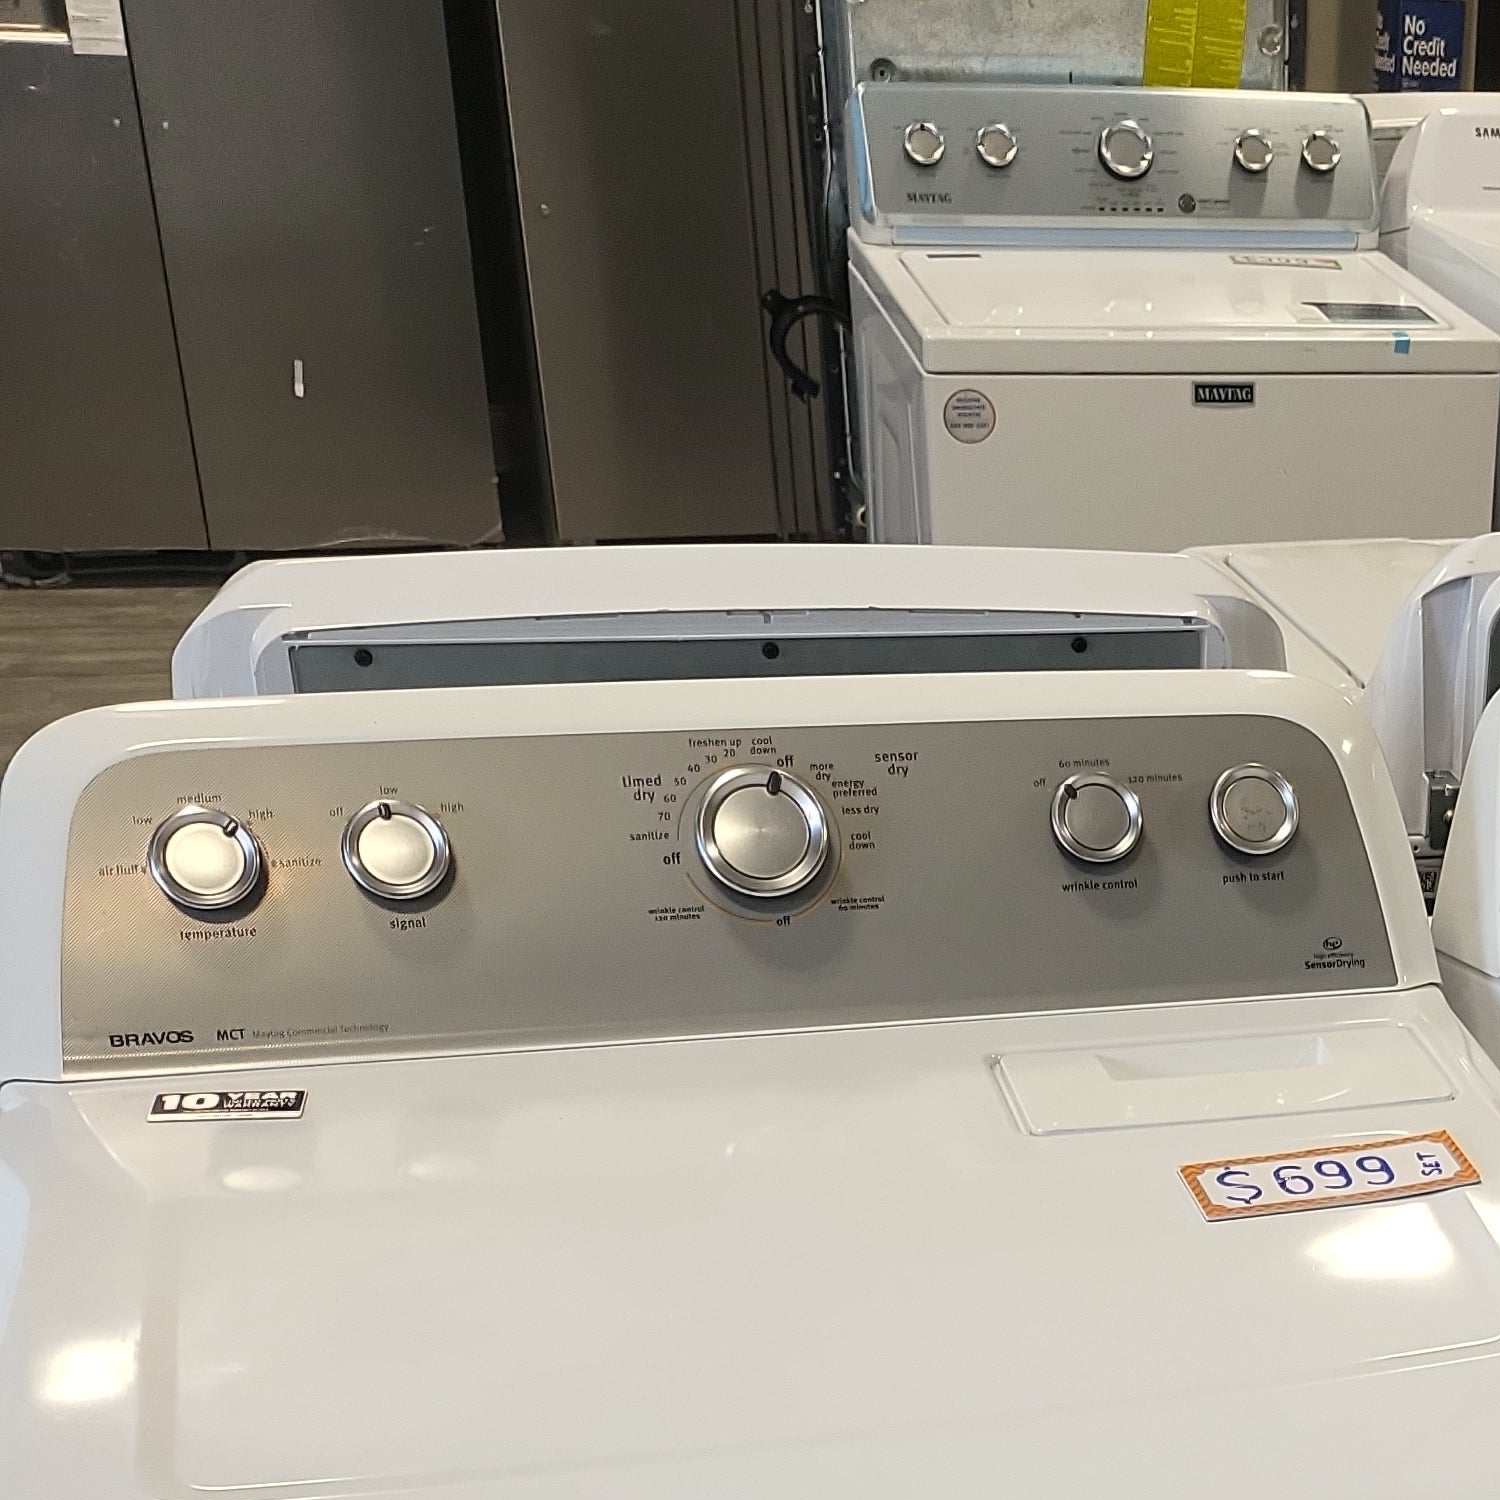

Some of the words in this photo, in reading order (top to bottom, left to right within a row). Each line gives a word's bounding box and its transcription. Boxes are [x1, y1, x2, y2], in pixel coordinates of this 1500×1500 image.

[1404, 14, 1426, 36] No
[1403, 35, 1446, 57] Credit
[1401, 55, 1457, 78] Needed
[1197, 387, 1252, 401] MAYTAG
[688, 738, 727, 748] freshen
[729, 738, 742, 749] up
[751, 736, 773, 746] cool
[723, 749, 736, 757] 20
[750, 746, 776, 755] down
[704, 755, 718, 764] 30
[776, 755, 794, 768] off
[874, 751, 919, 763] sensor
[687, 764, 700, 773] 40
[809, 763, 834, 771] more
[1058, 759, 1071, 769] 60
[1073, 757, 1110, 768] minutes
[887, 763, 909, 777] dry
[621, 774, 662, 788] timed
[673, 777, 687, 786] 50
[815, 771, 831, 782] dry
[1127, 775, 1145, 785] 120
[1145, 773, 1183, 783] minutes
[831, 779, 865, 789] energy
[1033, 778, 1046, 788] off
[379, 785, 398, 795] low
[832, 787, 878, 799] preferred
[176, 792, 222, 804] medium
[633, 789, 656, 804] dry
[663, 794, 677, 803] 60
[329, 807, 343, 817] off
[440, 802, 464, 814] high
[841, 806, 861, 815] less
[864, 805, 879, 816] dry
[248, 807, 274, 821] high
[657, 812, 671, 821] 70
[132, 815, 153, 825] low
[629, 831, 670, 841] sanitize
[850, 831, 872, 841] cool
[849, 840, 875, 850] down
[663, 852, 681, 865] off
[1222, 872, 1248, 885] push
[1249, 872, 1260, 882] to
[1262, 871, 1285, 882] start
[1061, 880, 1100, 892] wrinkle
[1102, 879, 1138, 890] control
[830, 897, 858, 905] wrinkle
[859, 895, 885, 904] control
[389, 916, 426, 931] signal
[776, 915, 791, 926] off
[179, 926, 257, 942] temperature
[1304, 959, 1366, 970] SensorDrying
[108, 1030, 195, 1048] BRAVOS
[216, 1028, 246, 1042] MCT
[252, 1028, 286, 1040] Maytag
[340, 1022, 390, 1034] Technology
[161, 1093, 220, 1111] 10
[227, 1091, 298, 1101] YEAR
